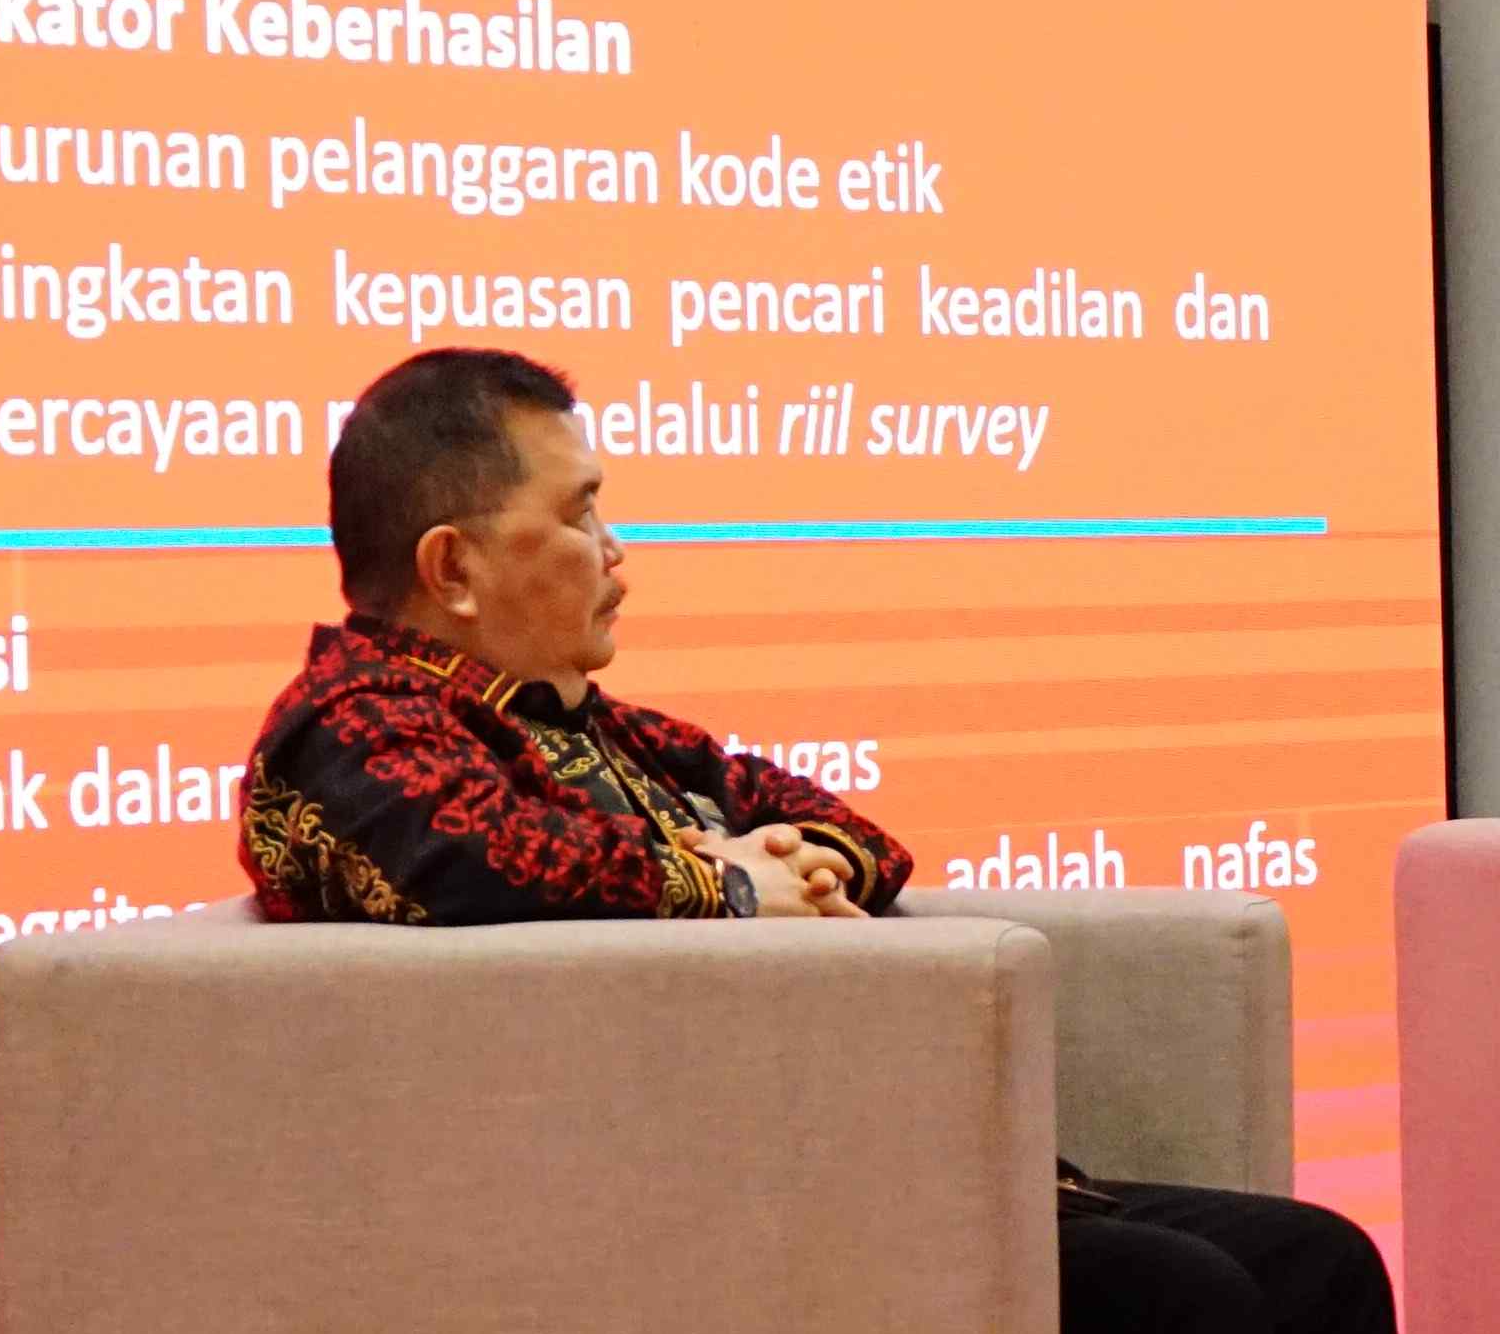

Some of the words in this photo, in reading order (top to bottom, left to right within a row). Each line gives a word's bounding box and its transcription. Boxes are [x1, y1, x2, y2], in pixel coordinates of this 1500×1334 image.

[269, 115, 660, 218] pelanggaran
[678, 129, 822, 211] kode
[837, 139, 945, 215] etik
[333, 247, 632, 345] kepuasan
[669, 265, 885, 349] pencari
[919, 263, 1144, 340] keadilan
[1173, 271, 1270, 342] dan
[777, 381, 855, 457] riil
[865, 403, 1050, 473] survey
[945, 828, 1126, 895] adalah
[1182, 819, 1319, 896] nafas
